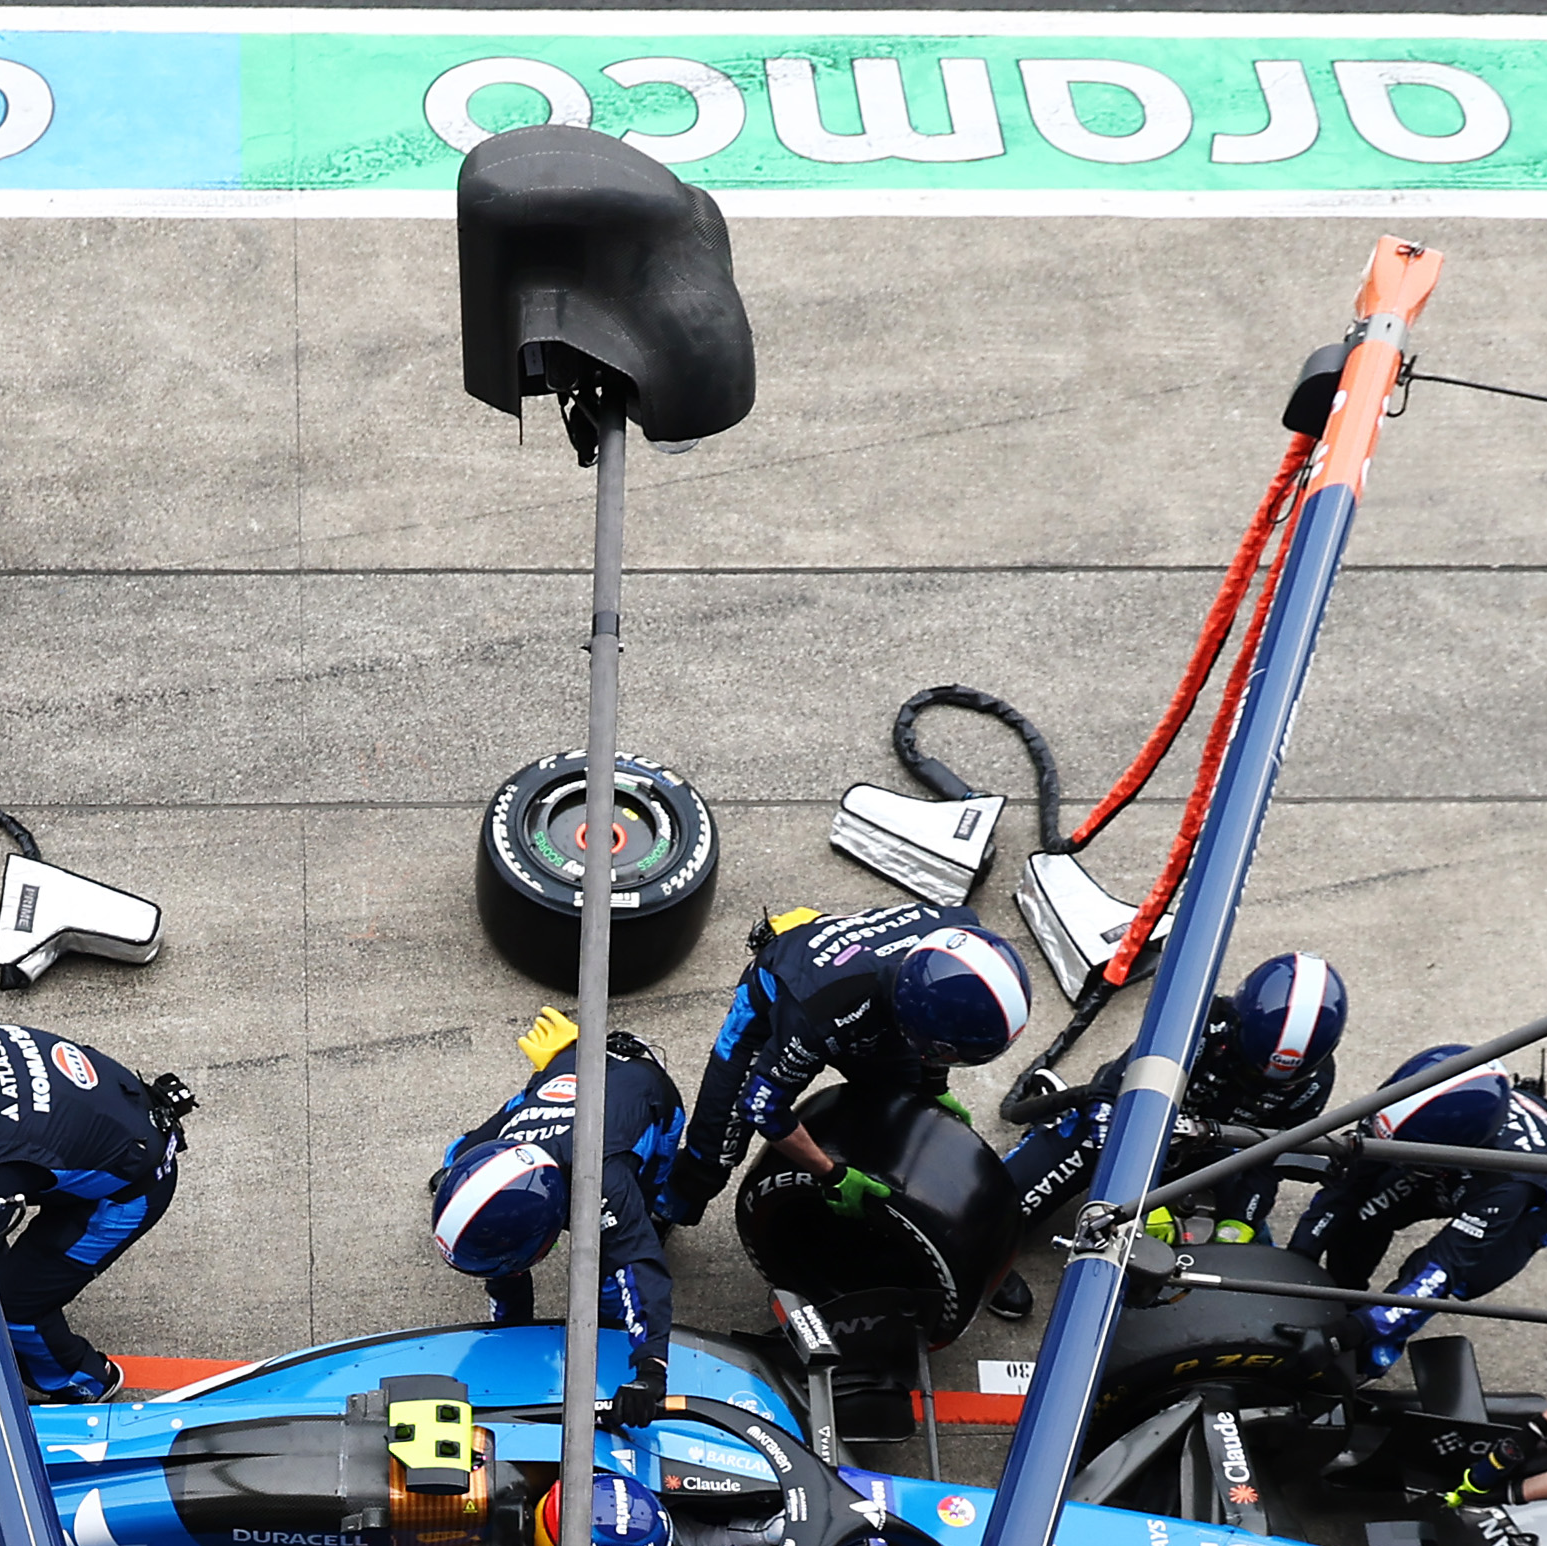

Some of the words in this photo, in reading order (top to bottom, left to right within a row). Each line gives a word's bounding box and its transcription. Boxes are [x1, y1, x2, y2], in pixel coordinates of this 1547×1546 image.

[424, 56, 1512, 165] aramco
[811, 909, 922, 968] ATLASSIAN
[2, 1022, 52, 1112] KOMATSU
[1271, 1053, 1304, 1067] Gulf
[790, 1309, 820, 1350] SCORES
[802, 1305, 832, 1346] betway
[757, 1431, 793, 1474] kraken
[1222, 1410, 1251, 1484] Claude
[612, 1478, 631, 1536] KOMATSU
[682, 1476, 742, 1493] Claude
